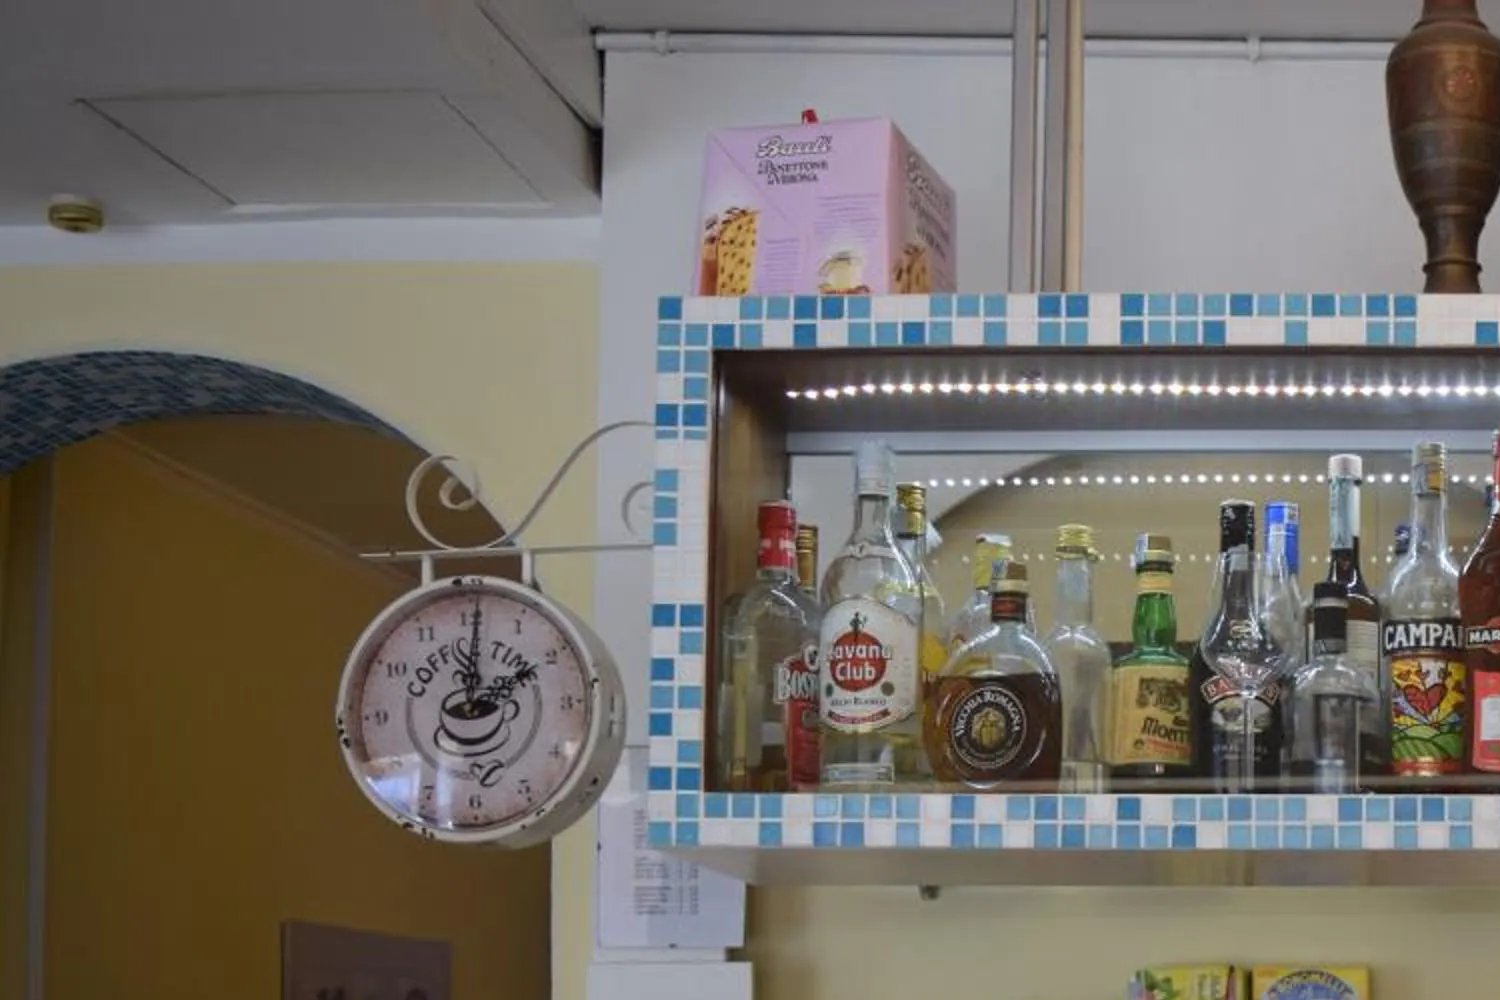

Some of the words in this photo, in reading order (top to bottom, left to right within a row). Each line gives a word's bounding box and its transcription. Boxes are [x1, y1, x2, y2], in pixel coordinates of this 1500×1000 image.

[417, 626, 435, 642] 11
[514, 619, 522, 635] 1
[545, 649, 558, 666] 2
[386, 662, 408, 678] 10
[835, 661, 877, 681] Club
[560, 696, 574, 711] 3
[374, 708, 389, 726] 9
[517, 779, 530, 795] 5
[469, 794, 482, 810] 6
